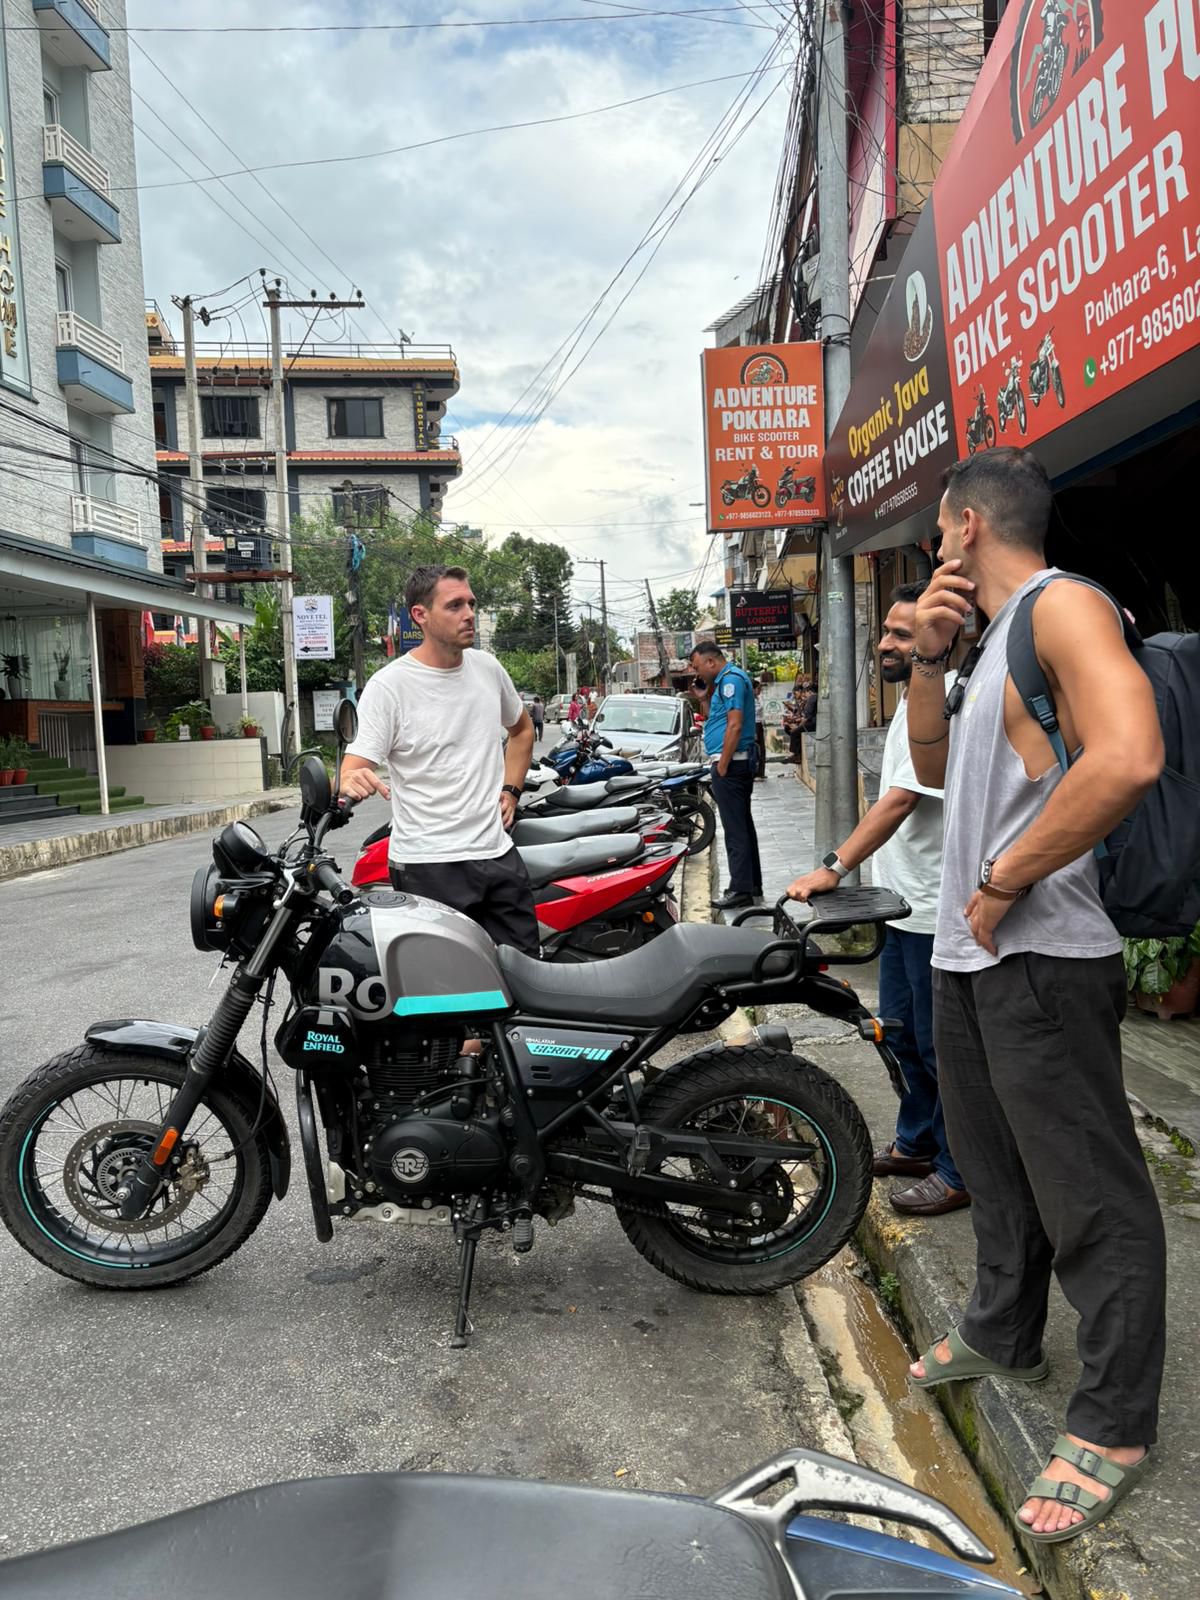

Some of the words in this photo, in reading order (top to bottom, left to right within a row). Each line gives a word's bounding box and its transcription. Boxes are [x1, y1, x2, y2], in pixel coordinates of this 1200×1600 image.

[946, 44, 1133, 324] ADVENTURE
[953, 291, 1012, 387] BIKE
[1017, 130, 1190, 330] SCOOTER
[1084, 244, 1177, 336] Pokhara-6,
[713, 385, 817, 408] ADVENTURE
[722, 408, 810, 431] POKHARA
[849, 396, 893, 458] Organic
[894, 365, 930, 428] Java
[734, 433, 755, 443] BIKE
[758, 431, 800, 442] SCOOTER
[715, 446, 755, 462] RENT
[760, 446, 773, 460] &
[777, 444, 818, 459] TOUR
[847, 446, 893, 507] COFFEE
[894, 400, 949, 480] HOUSE
[735, 604, 788, 617] BUTTERFLY
[747, 617, 777, 625] LODGE
[402, 631, 425, 640] DARS
[307, 1030, 341, 1043] ROYAL
[302, 1041, 345, 1054] ENFIELD
[532, 1044, 580, 1056] SCRAM
